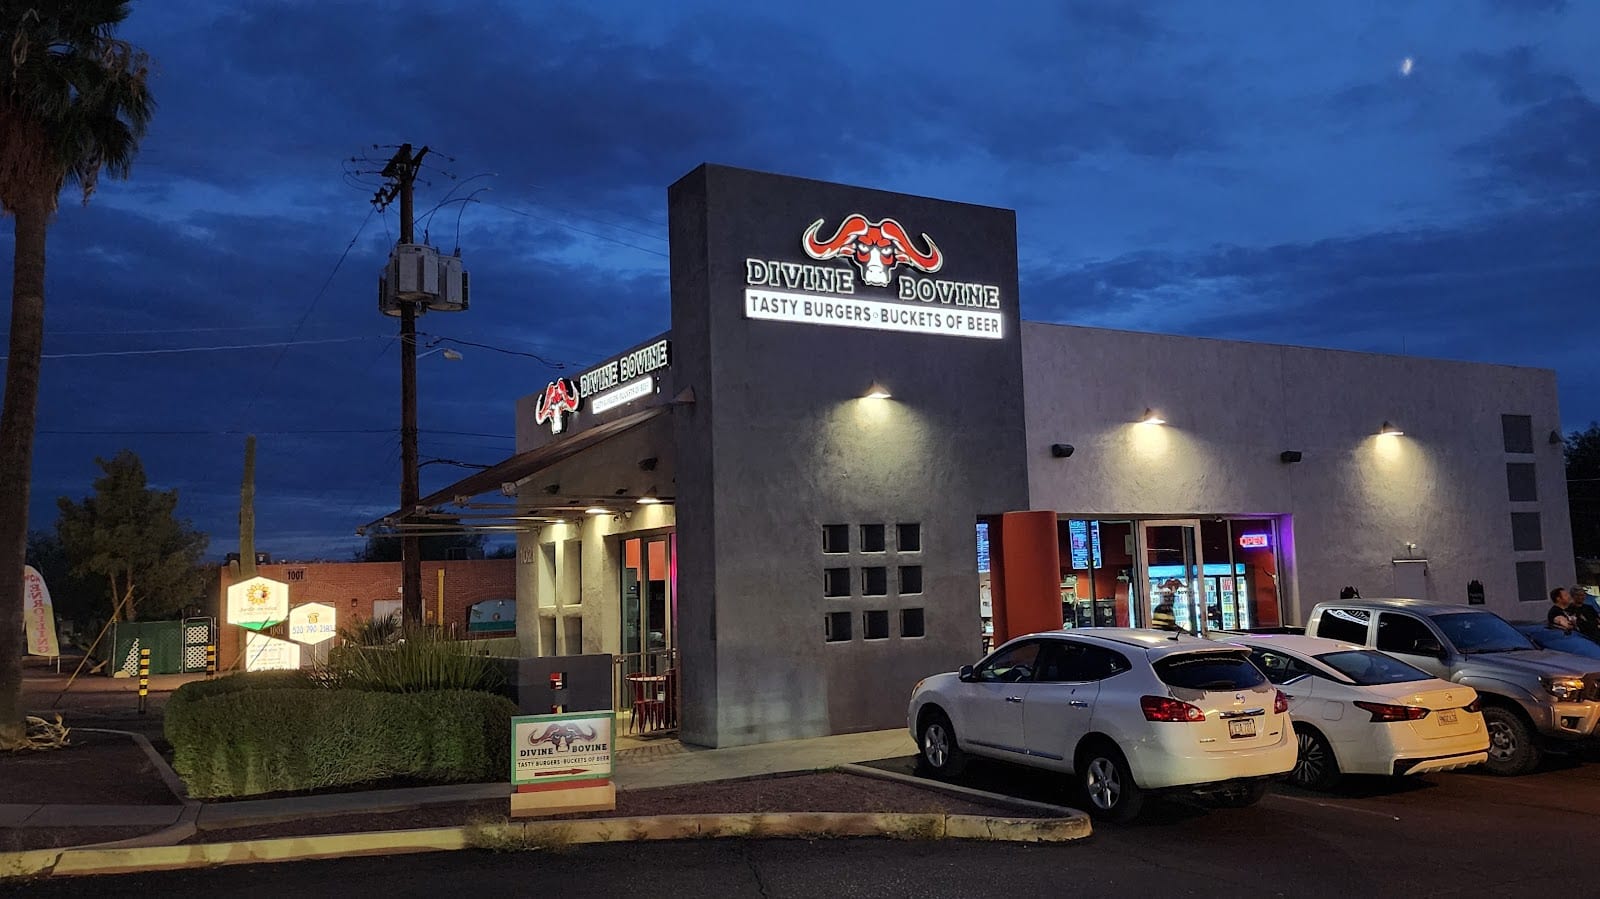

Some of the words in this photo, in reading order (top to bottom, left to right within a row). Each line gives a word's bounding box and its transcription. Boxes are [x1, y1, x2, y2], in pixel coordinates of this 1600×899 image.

[745, 258, 855, 295] DIVINE
[898, 275, 1001, 309] BOVINE
[750, 295, 797, 315] TASTY
[804, 300, 871, 322] BURGERS
[881, 308, 941, 328] BUCKETS
[946, 313, 962, 329] OF
[967, 316, 998, 333] BEER
[580, 360, 619, 398] DIVINE
[620, 340, 668, 382] BOVINE
[1239, 536, 1265, 546] OPEN
[287, 569, 304, 580] 1001
[292, 625, 303, 634] 520
[306, 625, 317, 633] 790
[520, 748, 554, 757] DIVINE
[572, 744, 607, 753] BOVINE
